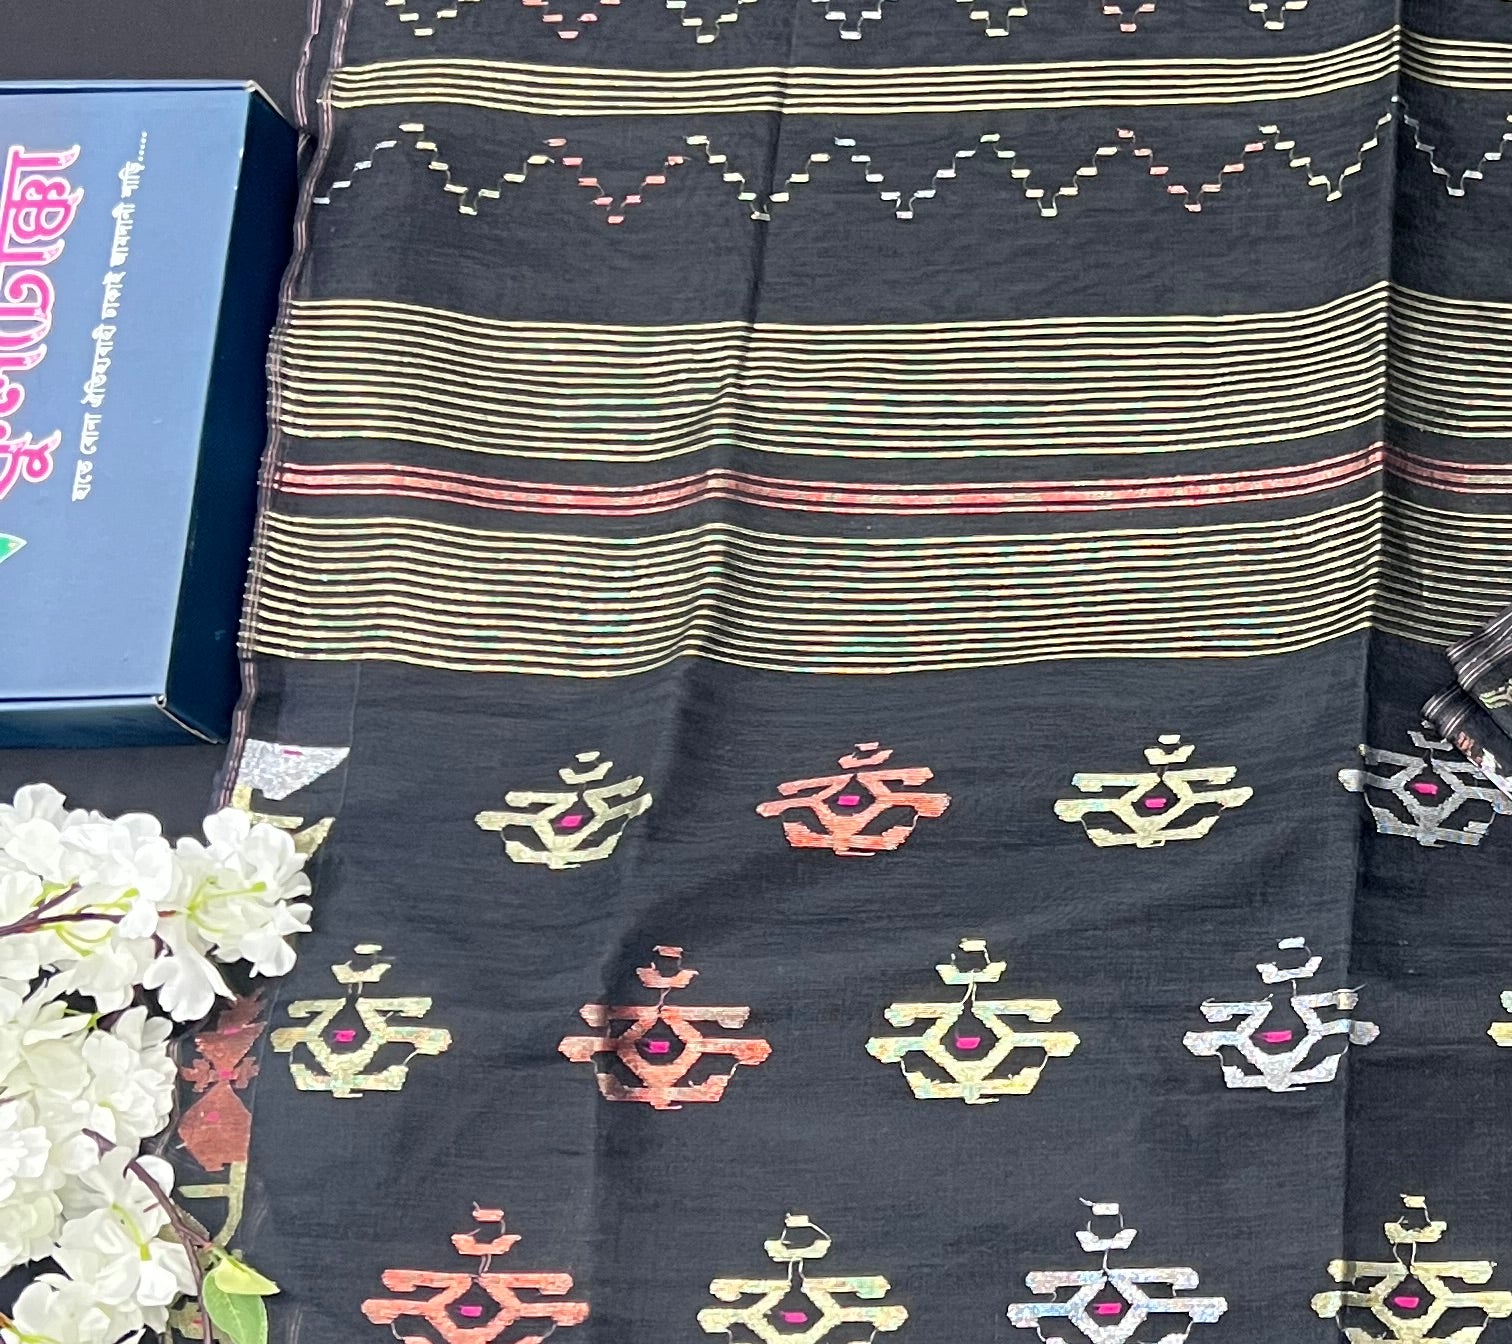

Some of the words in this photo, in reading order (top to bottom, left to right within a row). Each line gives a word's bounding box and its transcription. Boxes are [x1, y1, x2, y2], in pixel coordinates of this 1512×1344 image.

[101, 271, 127, 320] ঢাকাই
[80, 412, 103, 455] বোনা
[71, 459, 93, 502] হাতে
